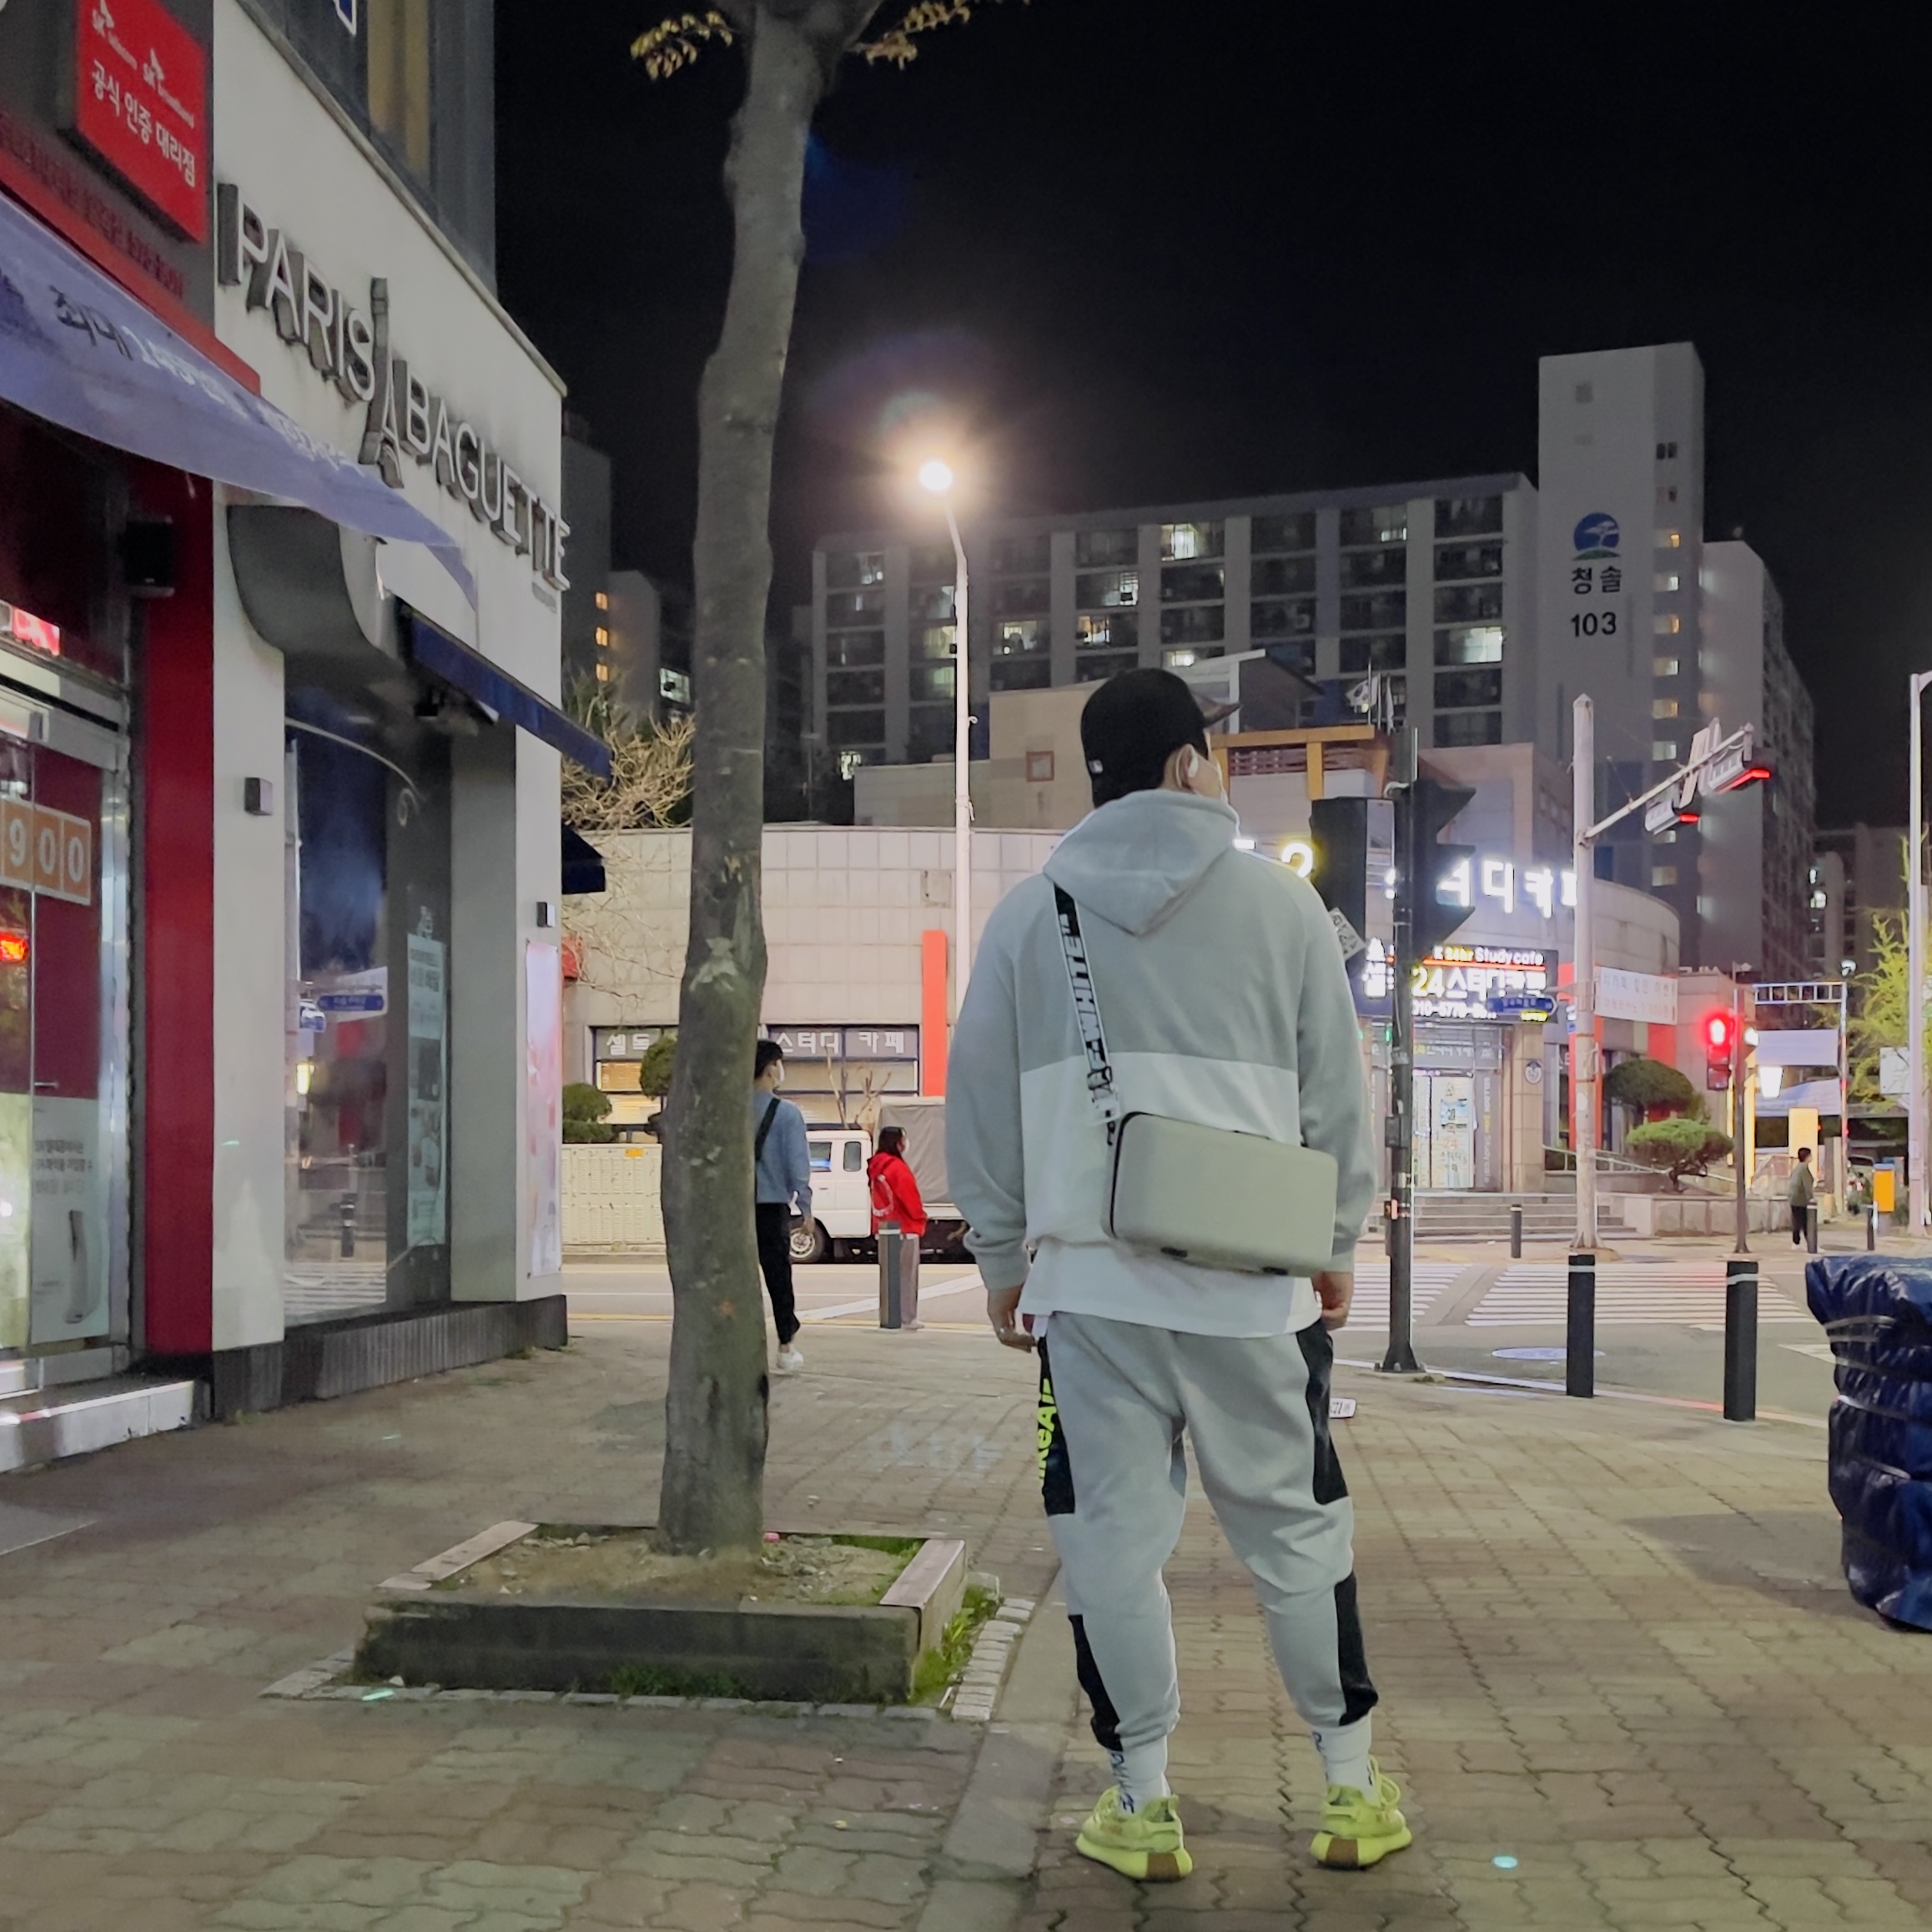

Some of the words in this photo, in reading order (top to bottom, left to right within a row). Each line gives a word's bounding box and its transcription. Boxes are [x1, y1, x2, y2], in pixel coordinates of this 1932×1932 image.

[92, 58, 120, 117] 공식
[125, 92, 153, 145] 인증
[155, 121, 196, 188] 대리점
[225, 194, 375, 402] PARIS
[404, 365, 571, 591] BAGUETTE
[1572, 566, 1623, 595] 청솔
[1571, 611, 1617, 637] 103
[9, 818, 85, 883] 900
[776, 1032, 840, 1054] 스터디
[858, 1032, 905, 1054] 카페
